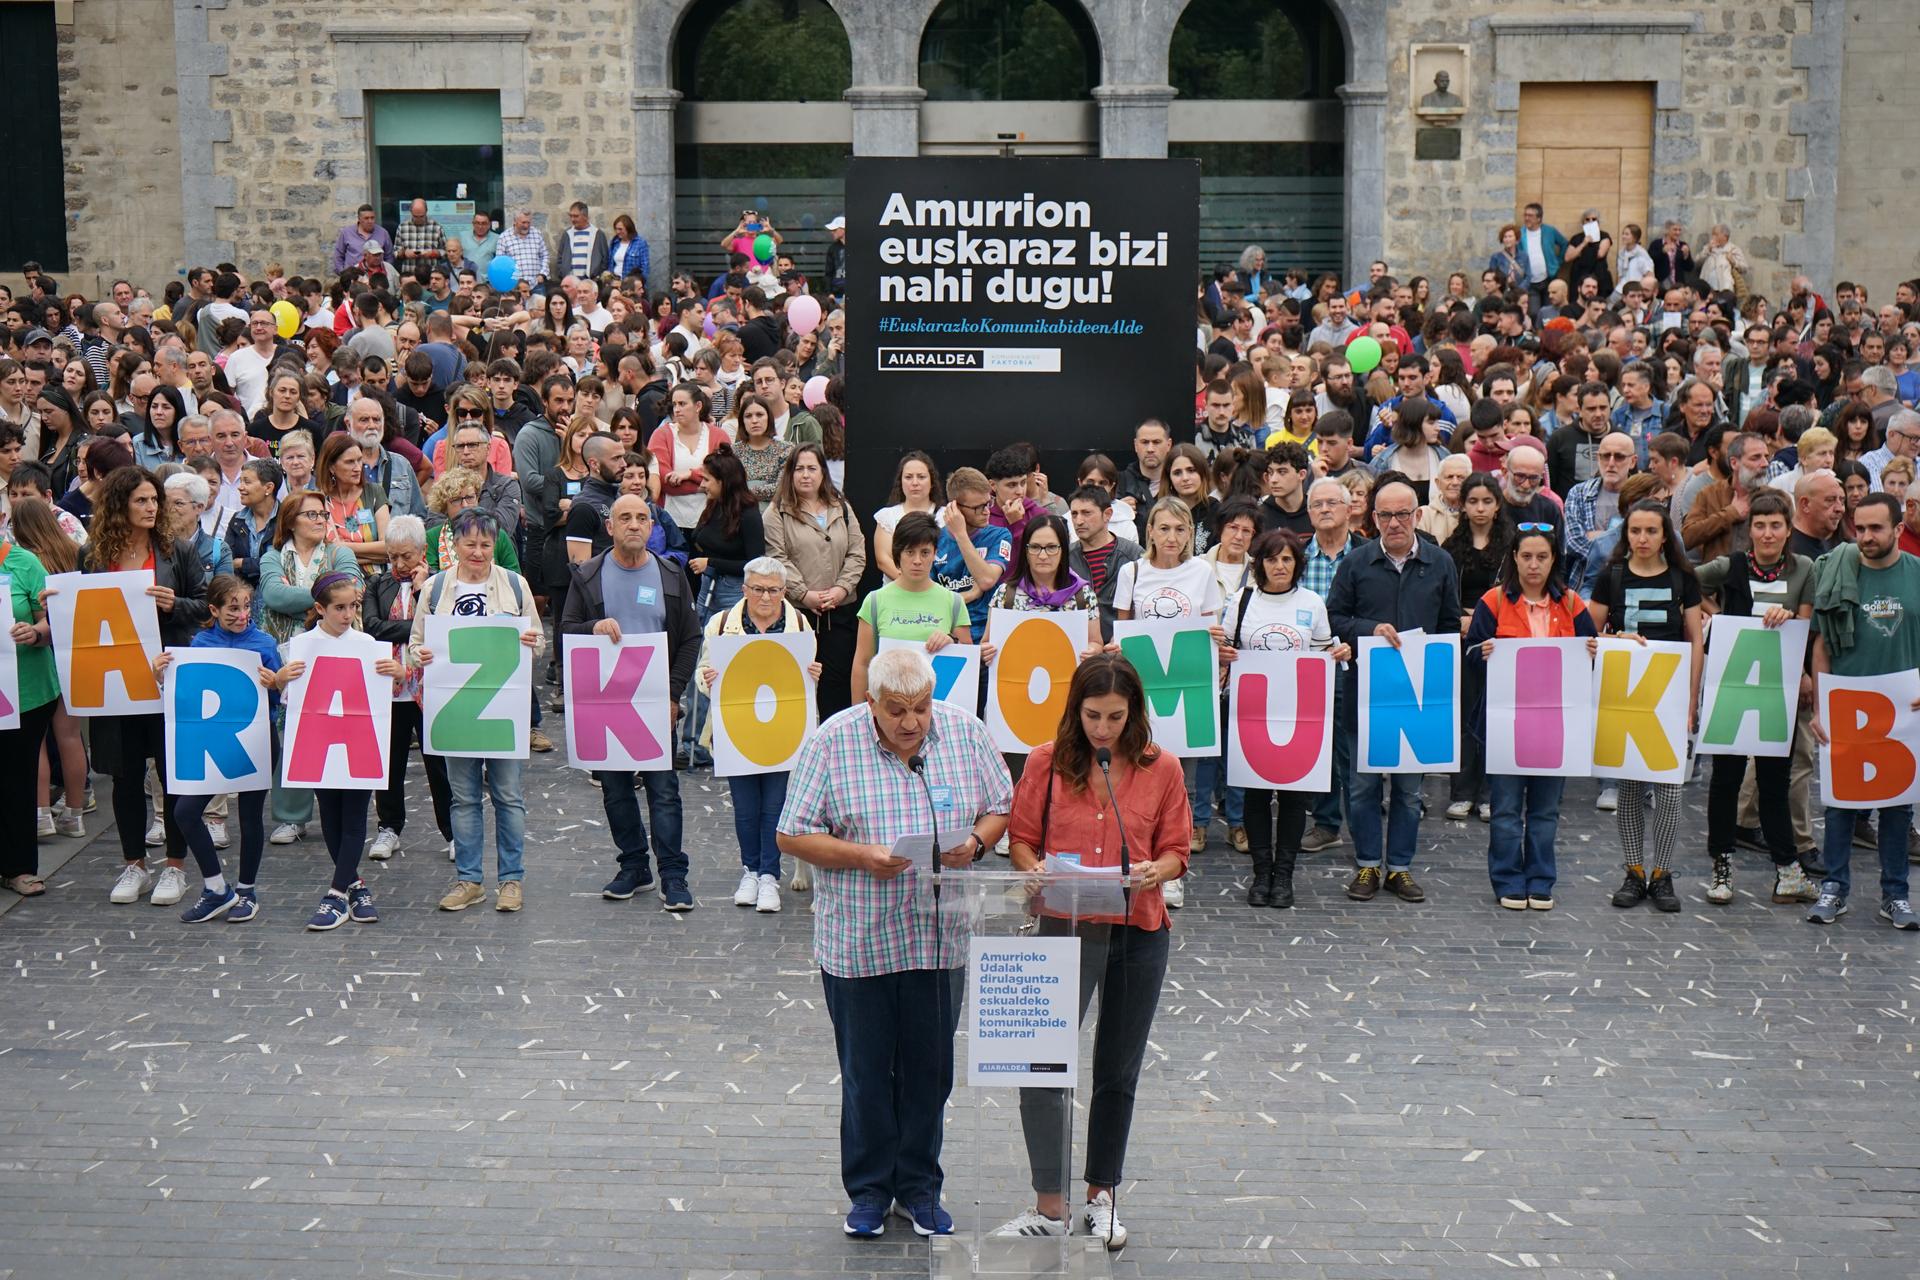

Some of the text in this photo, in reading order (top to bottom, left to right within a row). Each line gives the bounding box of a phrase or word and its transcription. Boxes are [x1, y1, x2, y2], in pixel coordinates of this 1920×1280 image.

[879, 193, 1091, 228] Amurrion
[879, 231, 1168, 267] euskaraz bizi
[879, 317, 1144, 335] #EuskarazkoKomunikabideenAlde
[880, 269, 1113, 310] nahi dugu!
[888, 353, 977, 365] AIARALDEA
[70, 587, 161, 707] A
[431, 626, 520, 752] Z
[571, 646, 663, 761] K
[720, 640, 806, 766] O
[998, 618, 1077, 747] O
[1120, 630, 1216, 748] M
[1703, 628, 1788, 745] A
[175, 662, 259, 781] R
[287, 656, 384, 782] A
[1237, 657, 1326, 784] U
[1368, 642, 1455, 768] N
[1514, 646, 1564, 769] I
[1593, 650, 1681, 771] K
[1829, 688, 1917, 801] B
[979, 1006, 1050, 1017] euskarazko
[980, 952, 1047, 962] Amurrioko
[980, 963, 1023, 973] Udalak
[980, 974, 1059, 985] dirulaguntza
[980, 985, 1041, 995] kendu dio
[980, 996, 1050, 1006] eskualdeko
[979, 1018, 1067, 1028] komunikabide
[979, 1029, 1035, 1039] bakarrari
